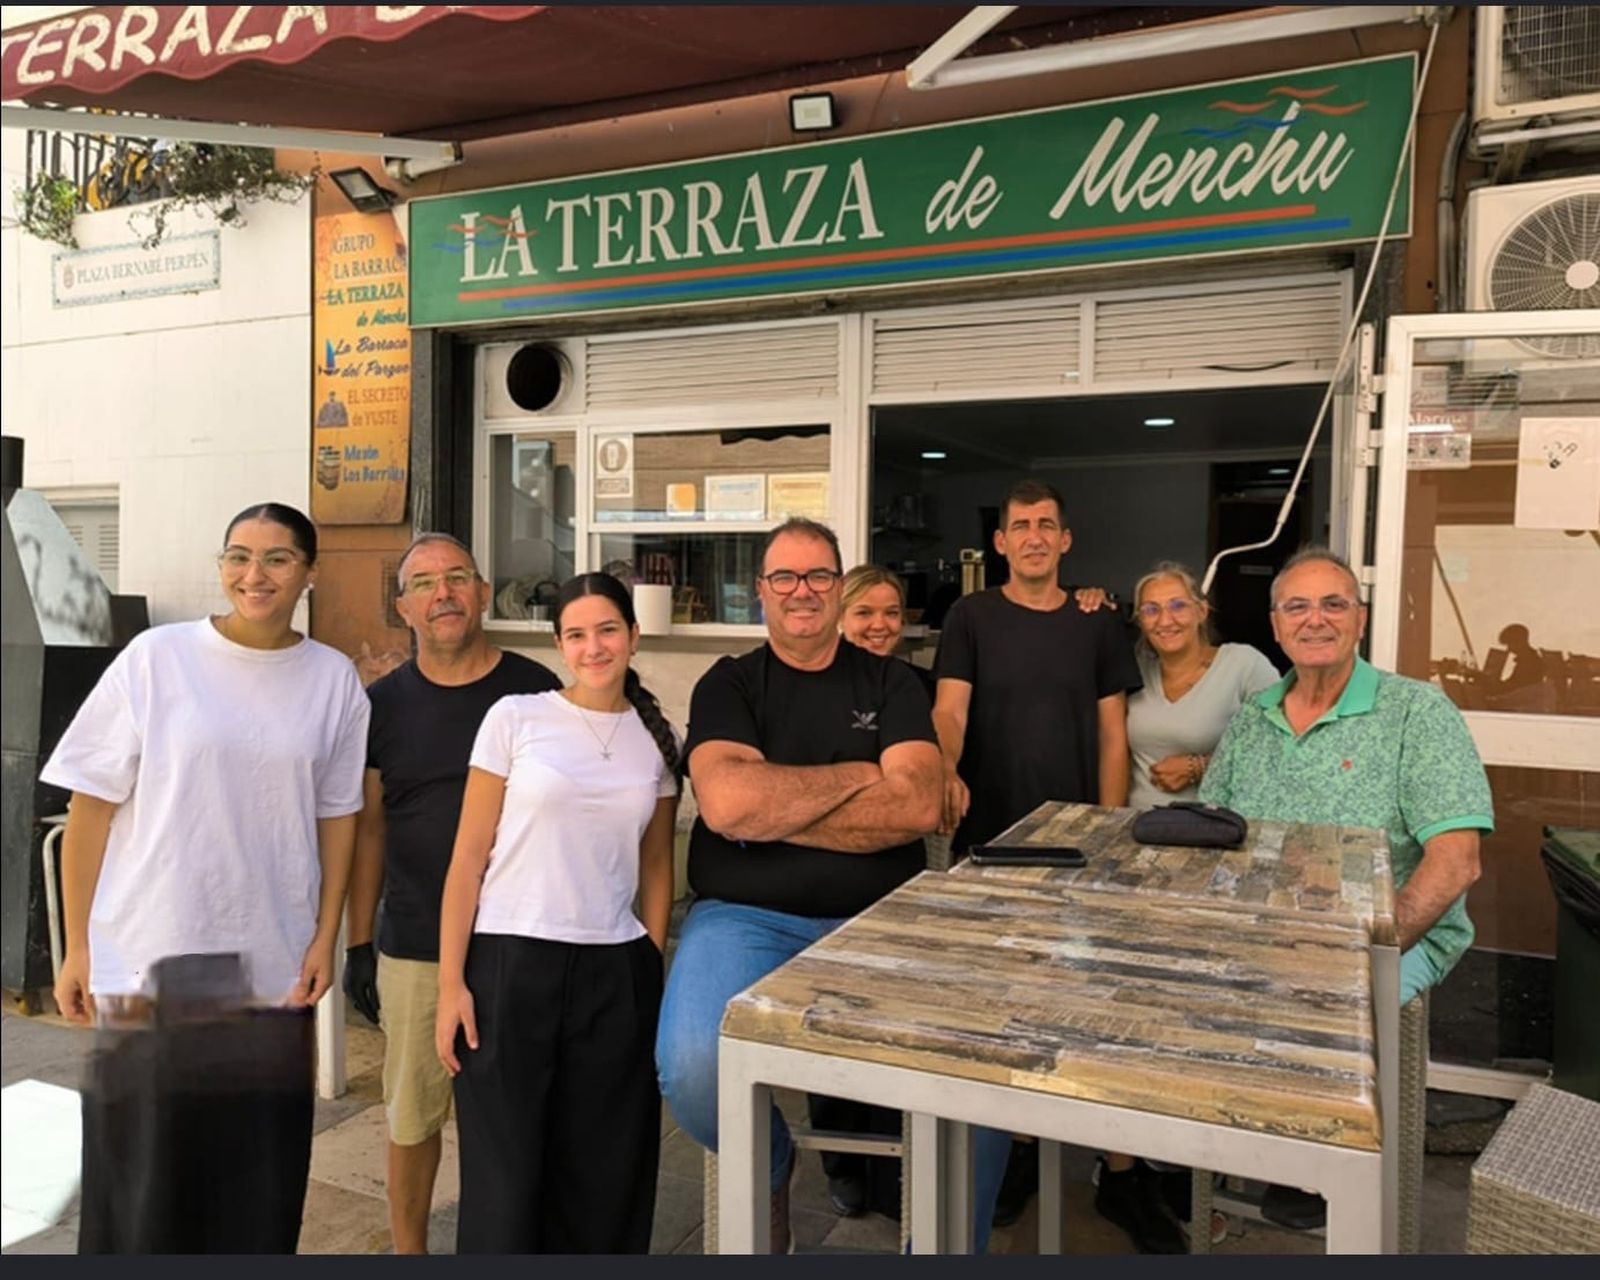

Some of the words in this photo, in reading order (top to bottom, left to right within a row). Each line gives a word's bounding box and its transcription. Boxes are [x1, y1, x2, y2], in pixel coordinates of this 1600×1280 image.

[460, 204, 539, 283] LA
[546, 157, 884, 273] TERRAZA
[925, 146, 1003, 234] de
[1049, 101, 1355, 219] Menchu
[333, 233, 375, 253] GRUPO
[77, 267, 110, 284] PLAZA
[334, 263, 350, 279] LA
[327, 288, 345, 305] LA
[347, 282, 405, 304] TERRAZA
[335, 339, 352, 355] La
[356, 336, 408, 353] Barraca
[341, 362, 364, 377] del
[365, 359, 409, 378] Parque
[348, 389, 360, 404] EL
[362, 386, 409, 402] SECRETO
[365, 409, 398, 426] YUSTE
[344, 466, 360, 481] Los
